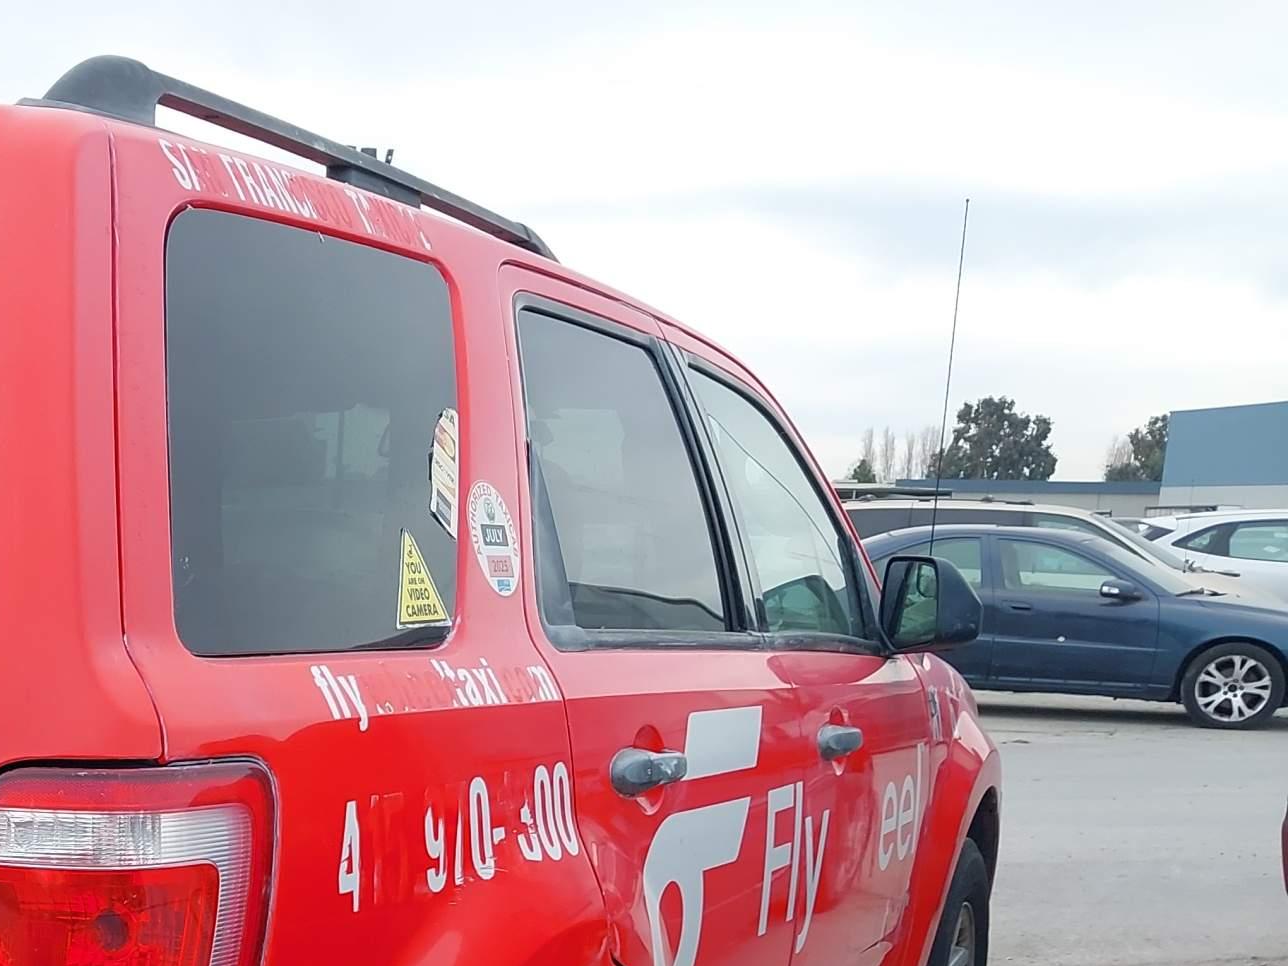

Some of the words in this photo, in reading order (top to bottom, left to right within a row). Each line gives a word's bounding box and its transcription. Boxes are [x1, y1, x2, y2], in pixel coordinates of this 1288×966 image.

[484, 527, 504, 543] JULY
[405, 561, 422, 575] YOU
[407, 588, 430, 601] VIDEO
[405, 603, 439, 617] CAMERA
